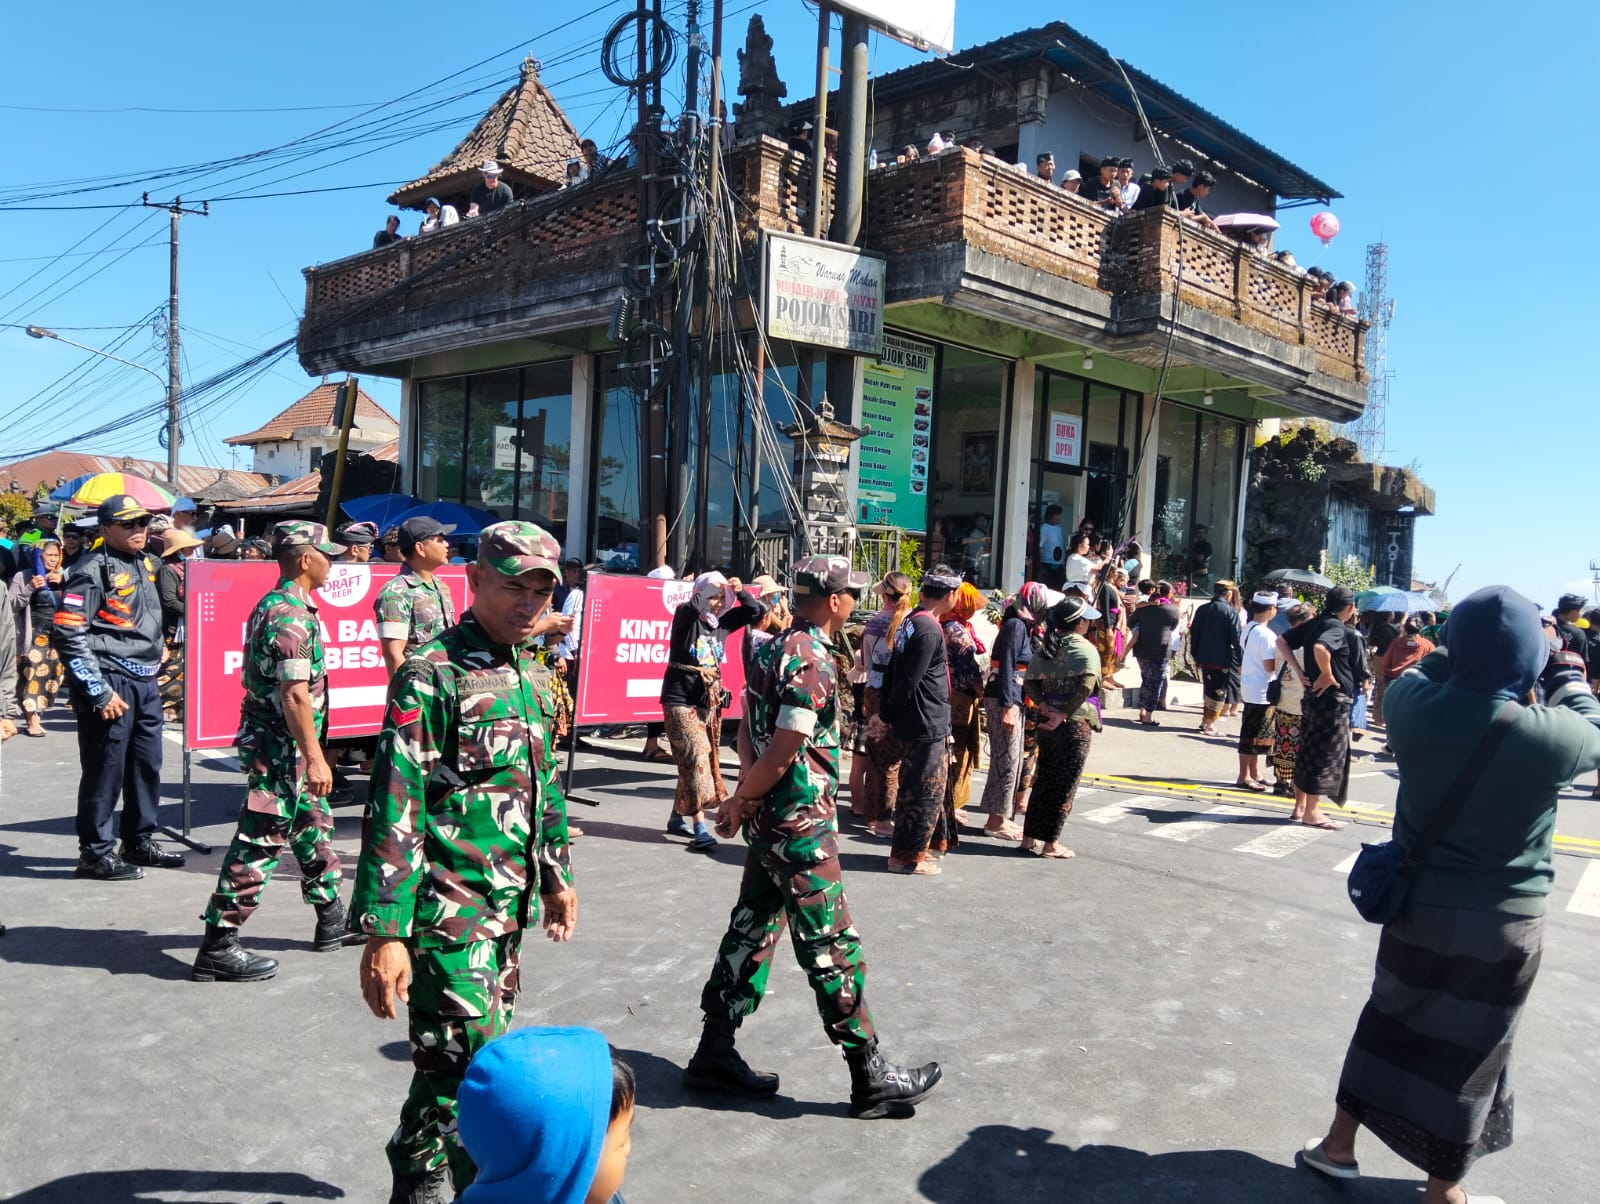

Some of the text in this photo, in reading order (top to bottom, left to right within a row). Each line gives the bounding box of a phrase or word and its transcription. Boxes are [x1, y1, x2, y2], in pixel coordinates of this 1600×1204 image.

[849, 268, 879, 290] Makan
[776, 295, 876, 336] POJOK SARI
[882, 346, 904, 365] OJOK
[905, 353, 926, 370] SARI
[1055, 423, 1075, 439] BUKA
[1055, 442, 1073, 457] OPEN
[322, 574, 363, 593] DRAFT
[331, 588, 352, 599] BEER
